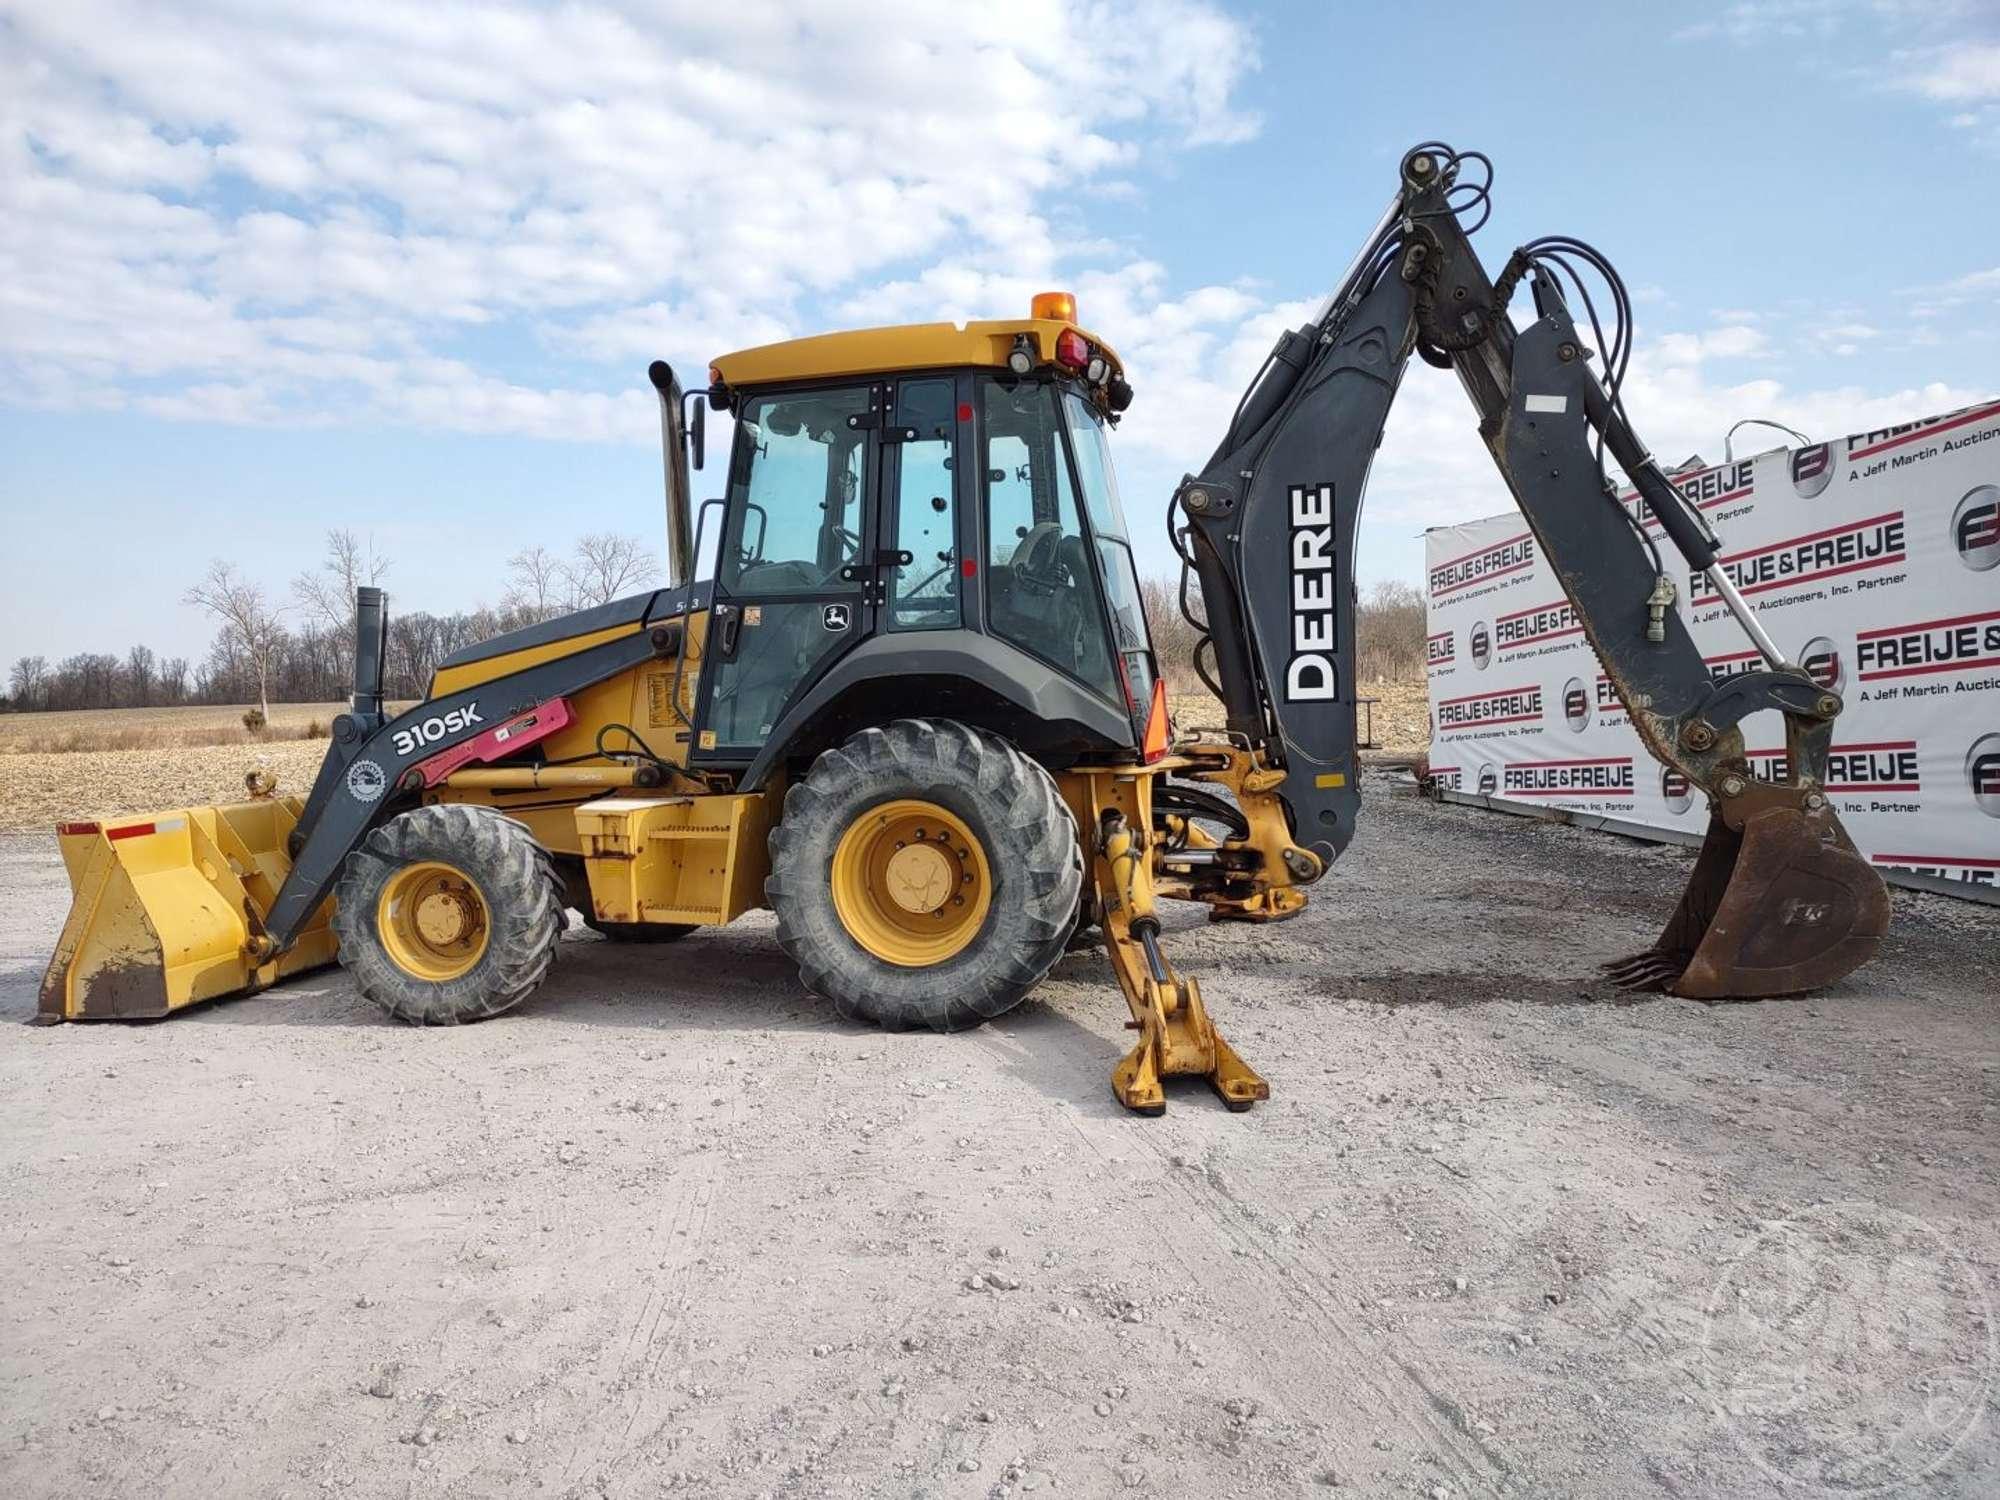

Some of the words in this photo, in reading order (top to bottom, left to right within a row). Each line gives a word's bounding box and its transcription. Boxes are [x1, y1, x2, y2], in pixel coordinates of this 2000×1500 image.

[1679, 459, 1754, 502] REIJE
[1849, 470, 1858, 482] A
[1863, 460, 1887, 478] Jeff
[1891, 447, 1938, 469] Martin
[1716, 505, 1754, 522] Partner
[1287, 486, 1336, 701] DEERE
[1692, 615, 1700, 625] A
[1702, 610, 1720, 623] Jeff
[1857, 573, 1908, 592] Partner
[1859, 691, 1871, 702] A
[1874, 687, 1899, 700] Jeff
[1902, 683, 1949, 698] Martin
[391, 702, 485, 757] 310SK
[1845, 802, 1866, 813] Inc.
[1870, 801, 1921, 813] Partner
